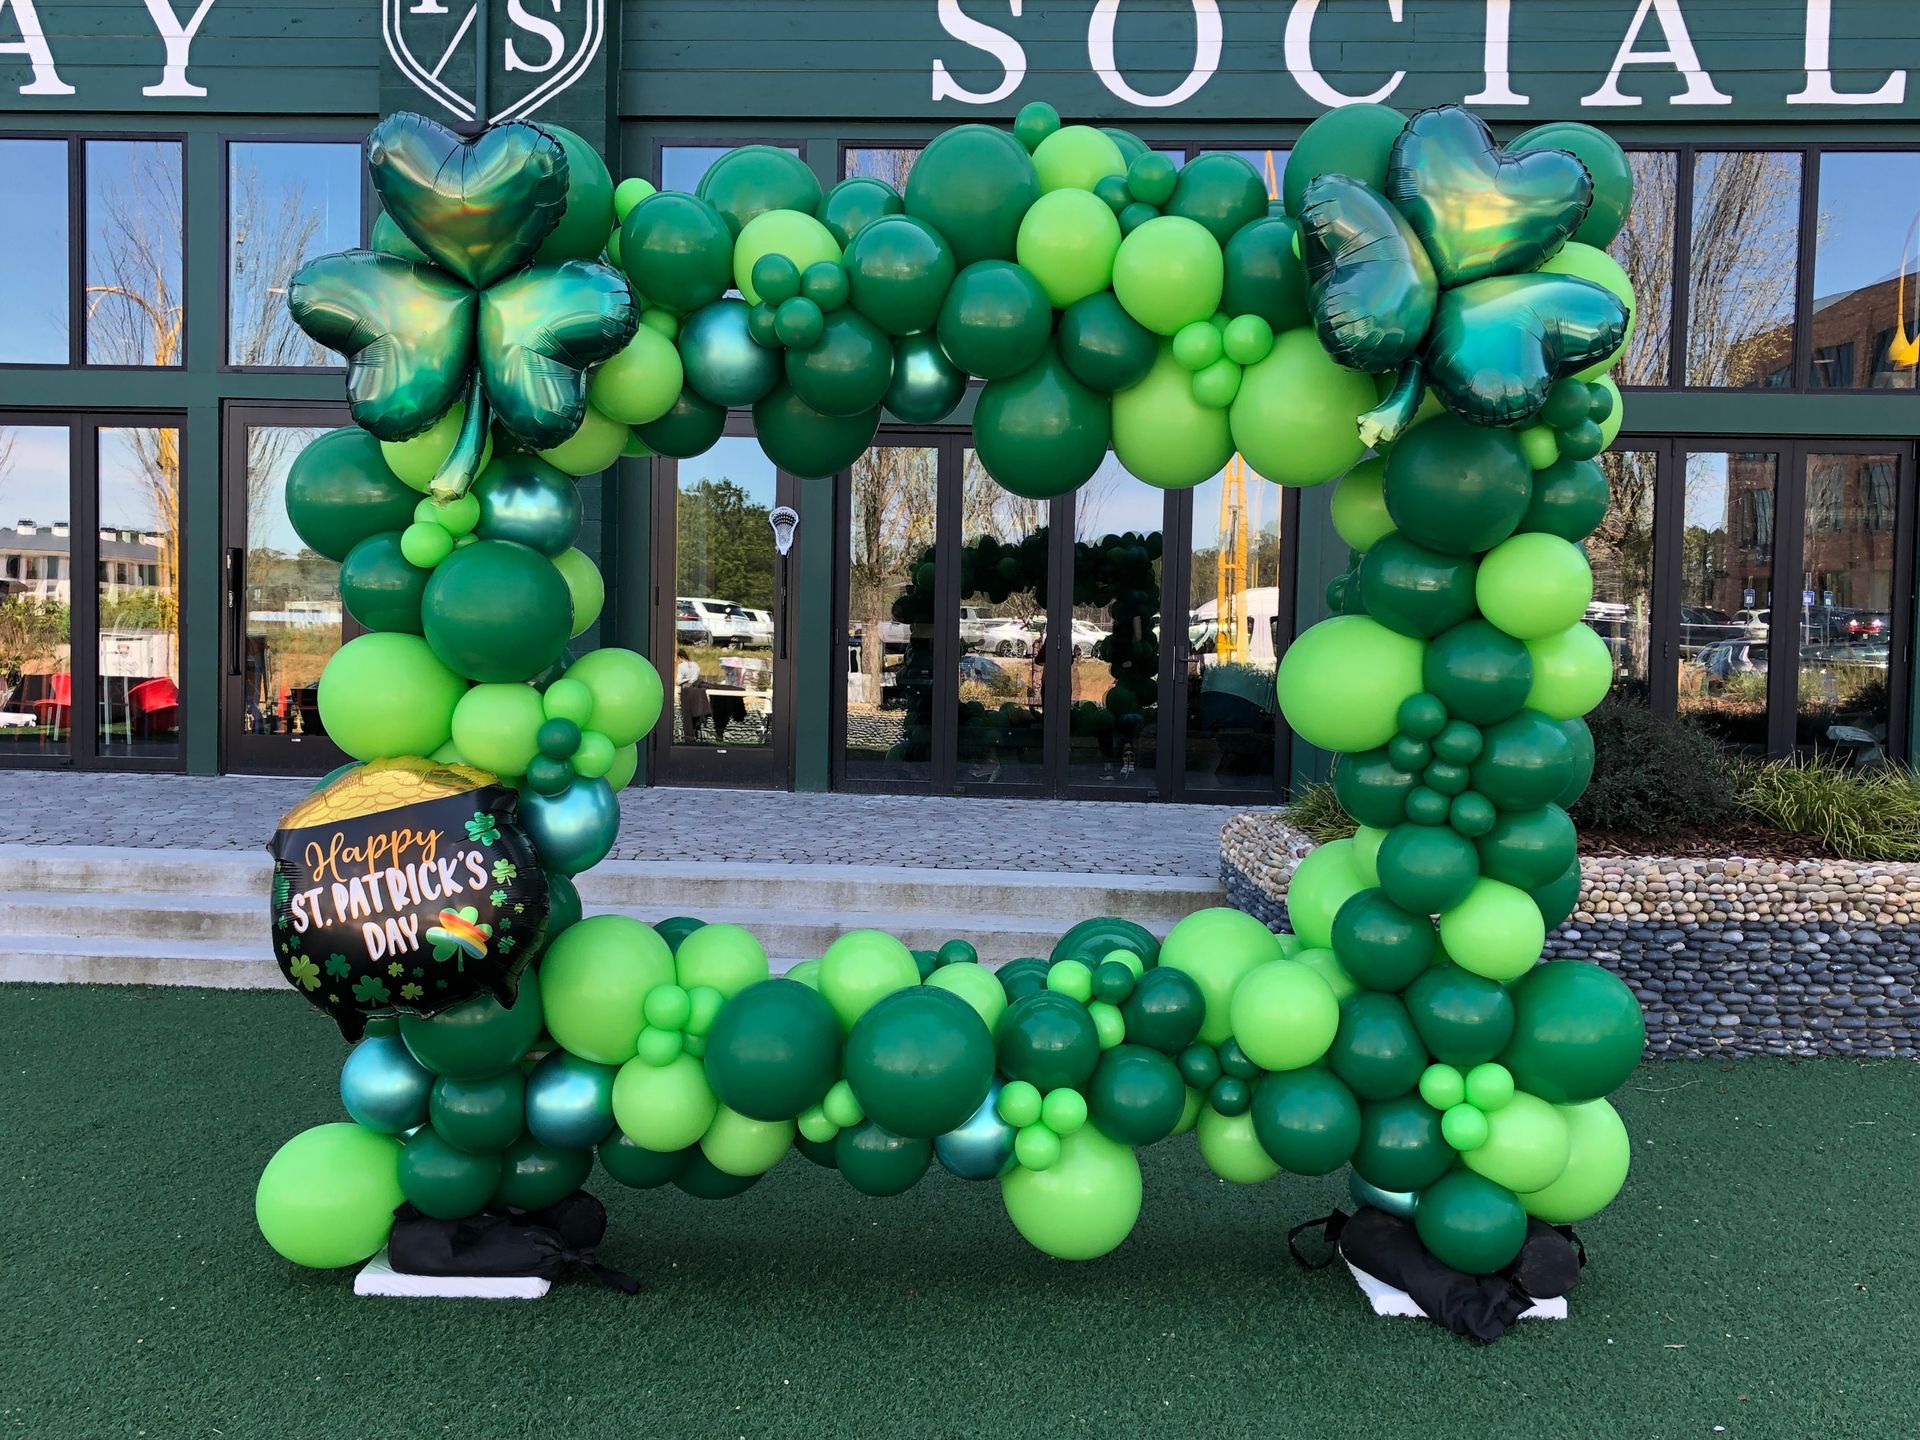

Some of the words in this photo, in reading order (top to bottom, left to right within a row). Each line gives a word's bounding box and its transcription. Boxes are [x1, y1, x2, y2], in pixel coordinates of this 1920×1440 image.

[932, 0, 1906, 107] SOCIAL
[304, 828, 445, 883] Happy
[361, 912, 421, 963] DAY
